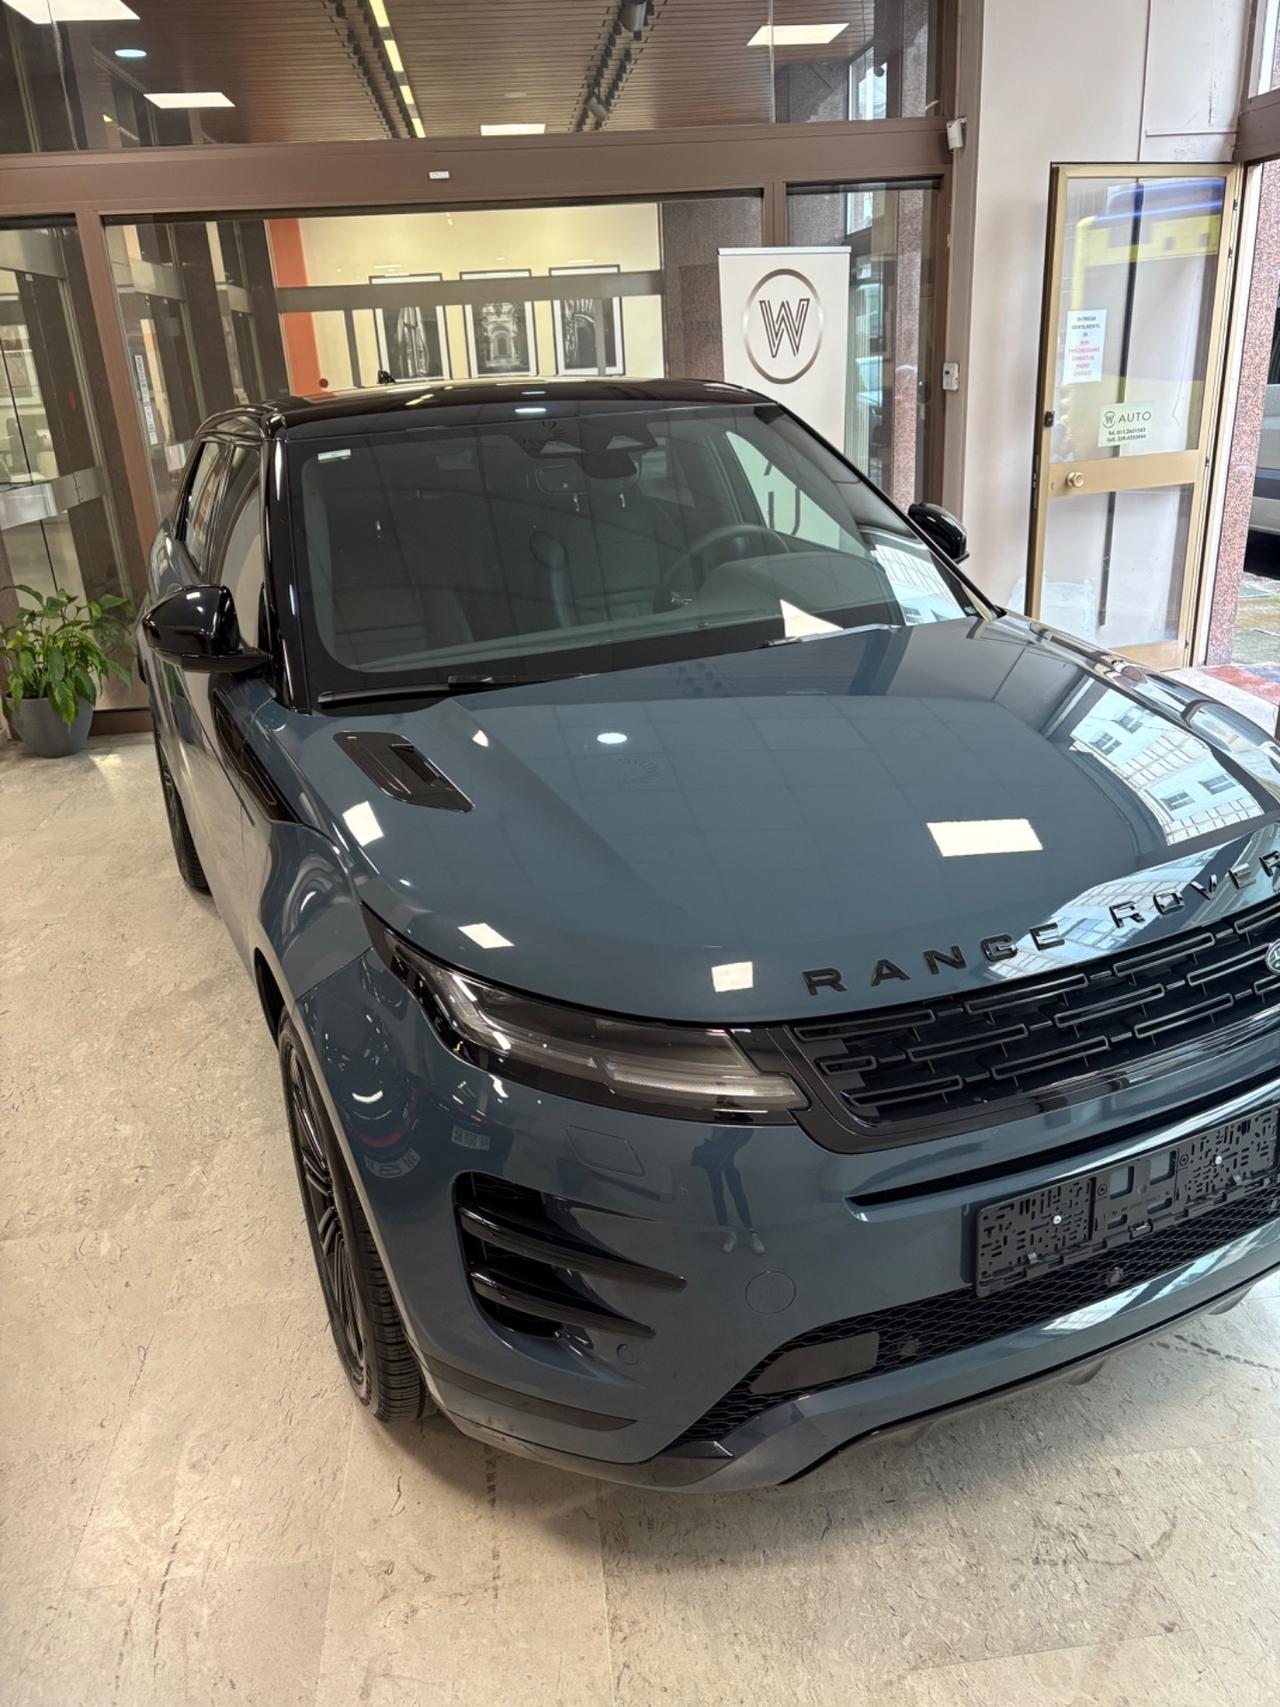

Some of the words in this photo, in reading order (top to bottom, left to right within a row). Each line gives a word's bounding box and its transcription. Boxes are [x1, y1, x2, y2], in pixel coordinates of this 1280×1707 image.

[759, 298, 810, 358] W
[1118, 411, 1151, 424] AUTO
[802, 922, 1066, 996] RANGE
